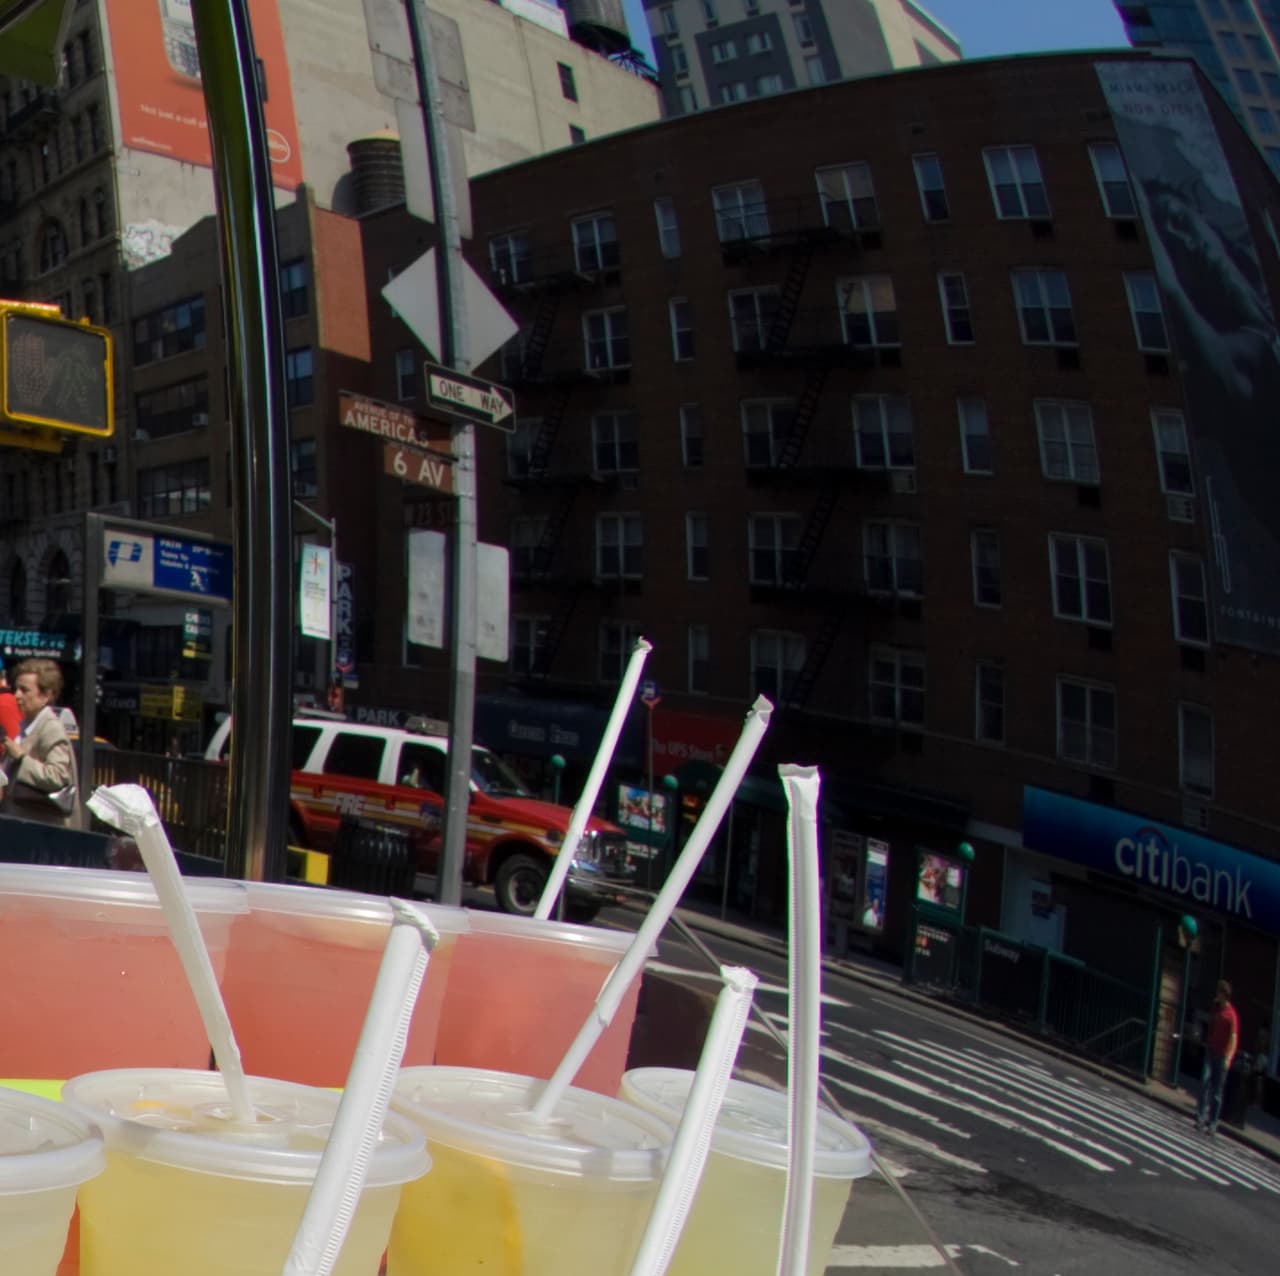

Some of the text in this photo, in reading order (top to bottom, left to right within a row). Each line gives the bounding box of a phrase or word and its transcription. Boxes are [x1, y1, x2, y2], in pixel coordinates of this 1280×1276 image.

[440, 380, 505, 414] ONE WAY
[344, 410, 429, 448] AMERICAS
[393, 450, 444, 486] 6 AV
[1114, 836, 1253, 919] citibank
